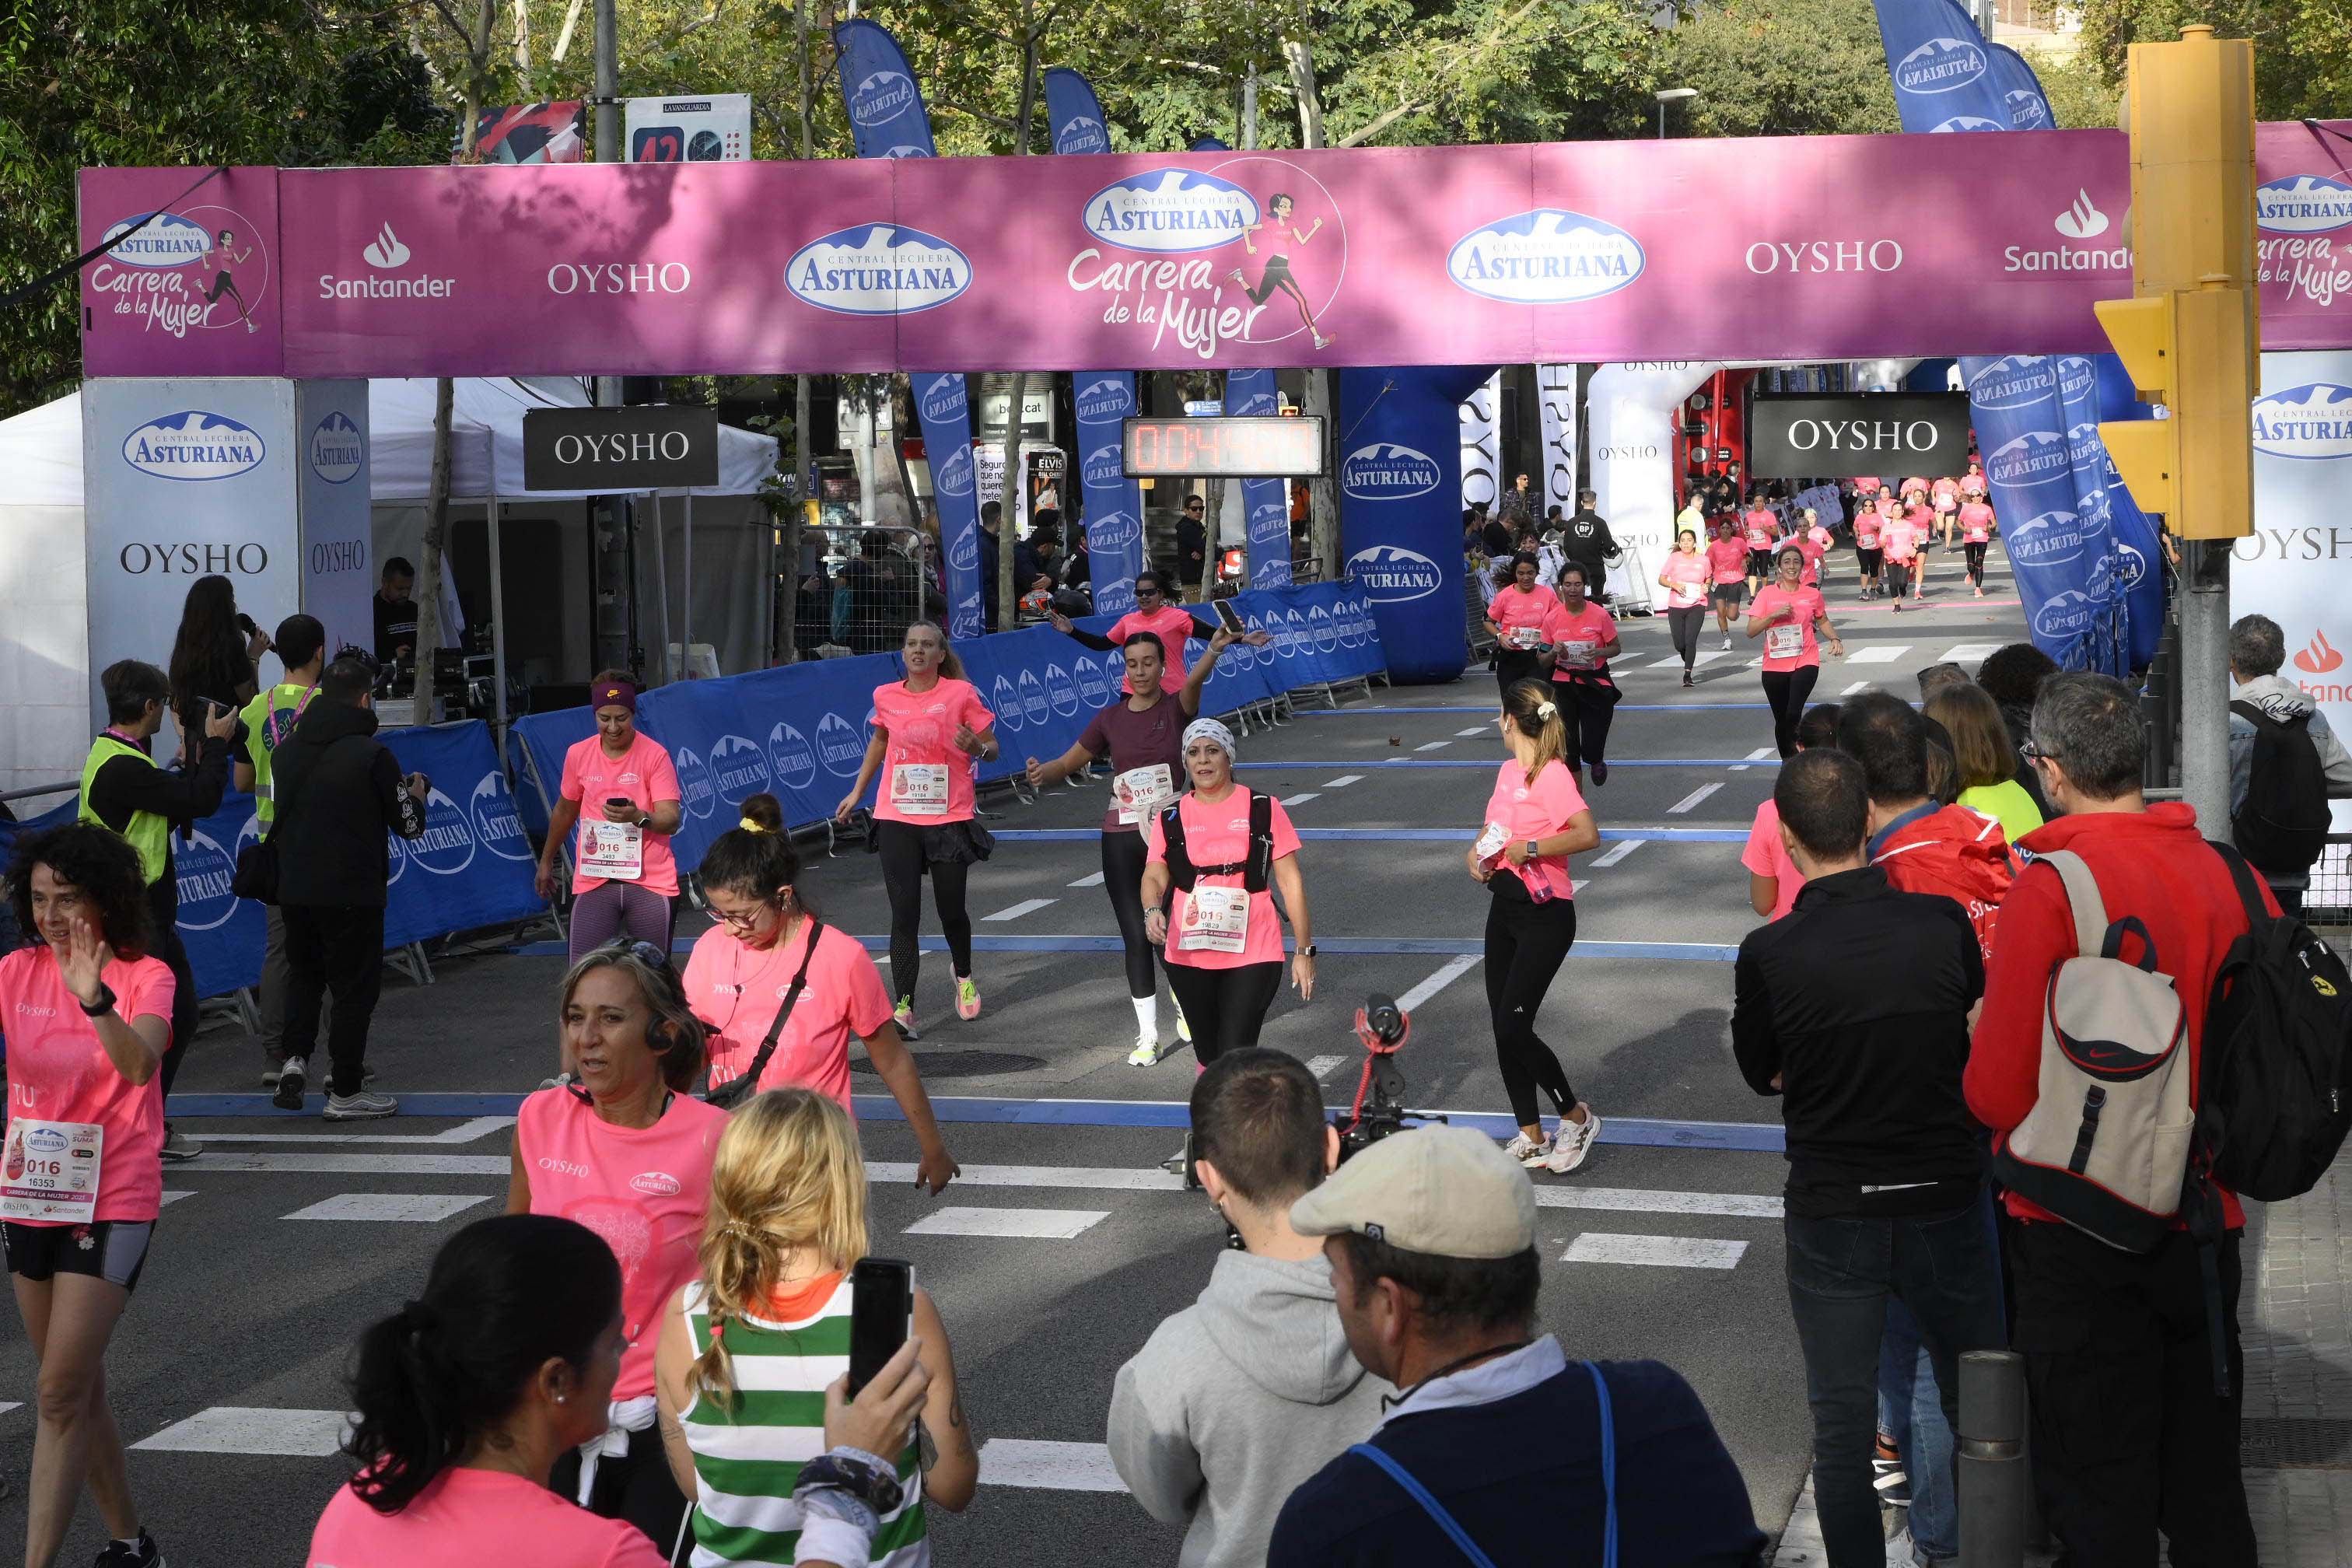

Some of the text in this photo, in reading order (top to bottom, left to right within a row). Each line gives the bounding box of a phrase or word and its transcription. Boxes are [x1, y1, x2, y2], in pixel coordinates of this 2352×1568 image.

[639, 135, 678, 163] 42
[1096, 200, 1245, 232] ASTURIANA
[110, 232, 203, 254] ASTURIANA
[2257, 237, 2332, 260] arrera
[893, 254, 952, 263] LECHERA
[1067, 248, 1213, 292] Carrera
[1462, 245, 1630, 280] ASTURIANA
[1745, 240, 1903, 275] OYSHO
[92, 264, 184, 292] Carrera
[320, 274, 455, 299] Santander
[548, 262, 691, 294] OYSHO
[800, 257, 957, 291] ASTURIANA
[2276, 261, 2290, 282] la
[2286, 257, 2352, 306] Muje
[114, 290, 218, 338] de la Mujer
[1104, 285, 1268, 359] de la Mujer
[1788, 419, 1939, 452] OYSHO
[2253, 412, 2352, 440] ASTURIA
[134, 436, 255, 464] ASTURIANA
[314, 439, 359, 466] ASTURIANA
[555, 432, 689, 465] OYSHO
[1598, 445, 1657, 460] OYSHO
[1038, 458, 1062, 470] ELVIS
[1346, 466, 1433, 487] ASTURIANA
[312, 540, 364, 575] OYSHO
[2232, 527, 2352, 562] OYSH
[120, 543, 268, 575] OYSHO
[774, 751, 814, 774] ASTURIANA
[821, 740, 864, 764] ASTURIANA
[715, 763, 769, 792] ASTURIANA
[1134, 786, 1153, 797] 016
[478, 808, 523, 840] ASTUR
[599, 843, 619, 852] 016
[1200, 911, 1223, 920] 016
[16, 1002, 57, 1017] OYSHO
[12, 1082, 35, 1108] TU
[26, 1159, 61, 1175] 016
[539, 1157, 590, 1178] OYSHO
[28, 1178, 55, 1189] 16353
